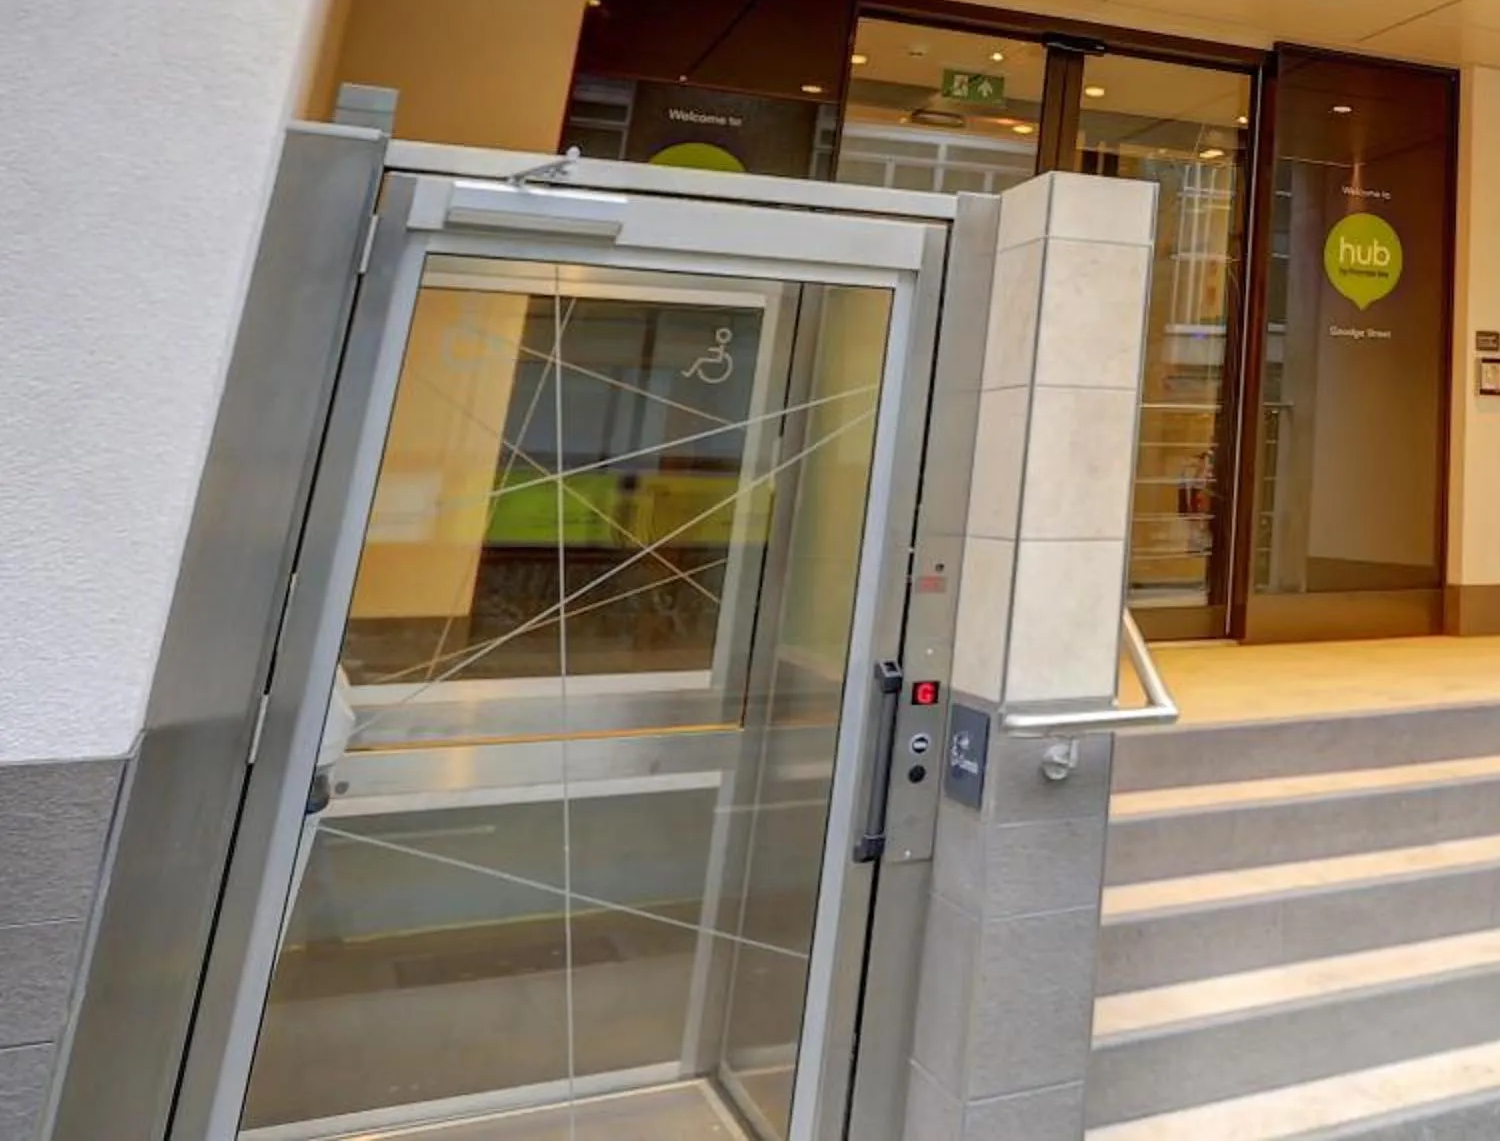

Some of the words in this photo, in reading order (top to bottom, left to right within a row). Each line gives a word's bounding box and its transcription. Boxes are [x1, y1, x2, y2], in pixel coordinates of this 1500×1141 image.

[668, 109, 726, 125] Welcome
[729, 115, 742, 127] to
[1338, 236, 1391, 266] hub
[918, 684, 935, 703] G
